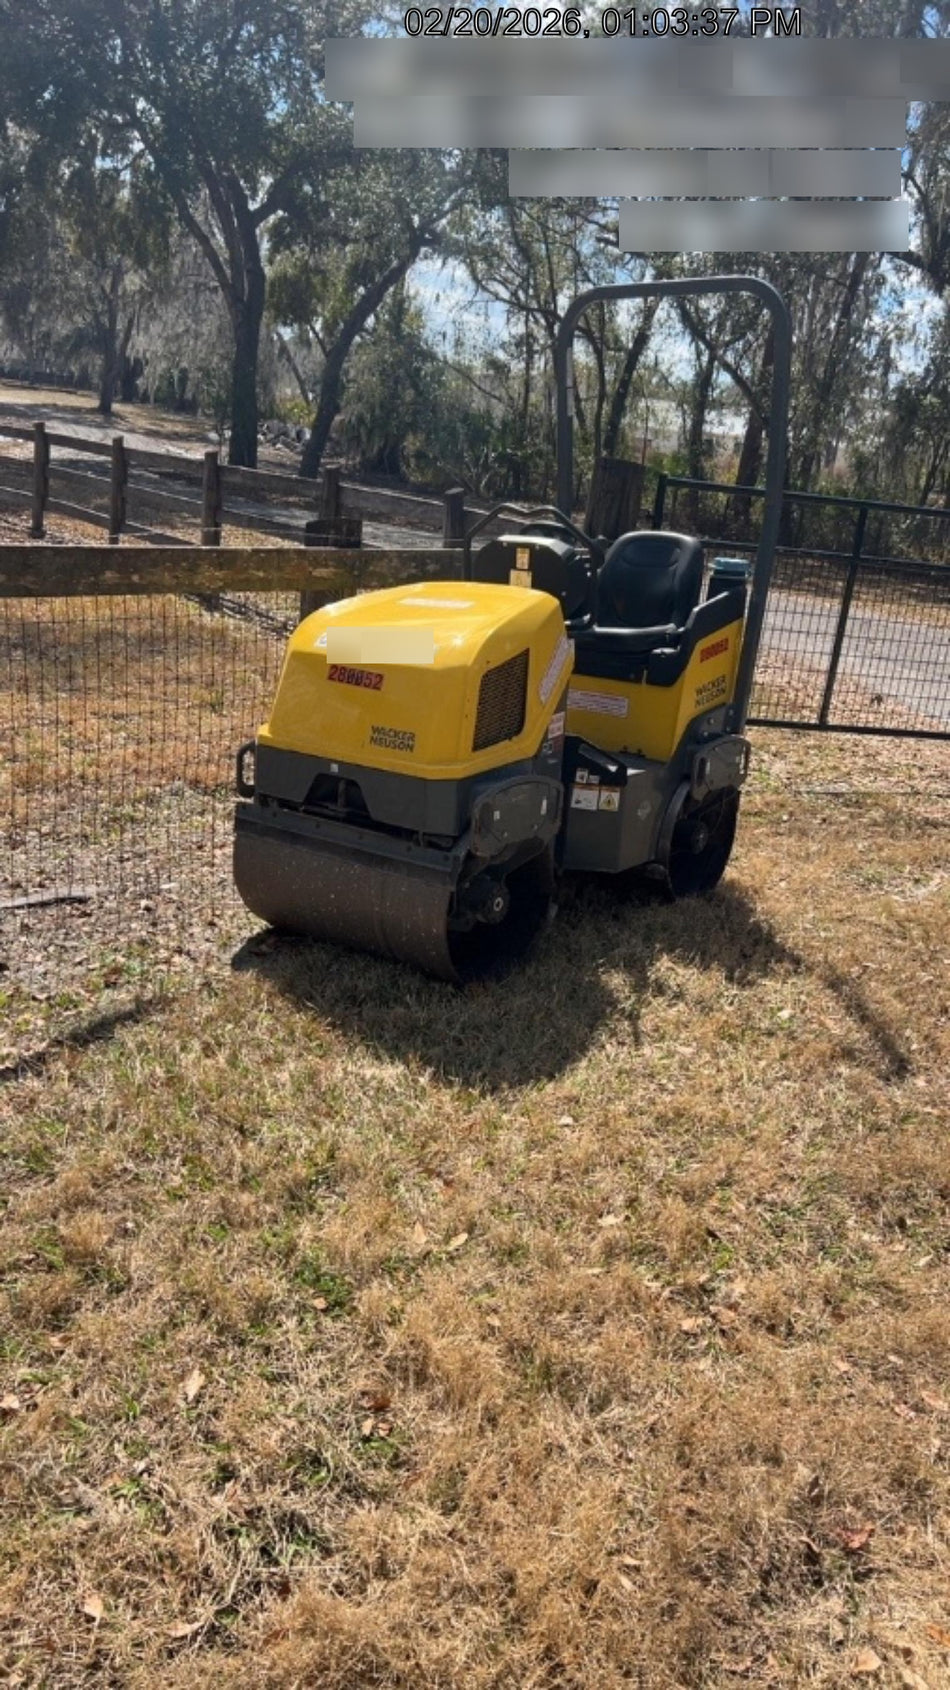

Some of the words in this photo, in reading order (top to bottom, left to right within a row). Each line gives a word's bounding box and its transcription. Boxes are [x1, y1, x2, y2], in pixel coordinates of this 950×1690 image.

[328, 664, 384, 691] 280052
[371, 725, 416, 742] WACKER
[369, 735, 415, 753] NEUSON
